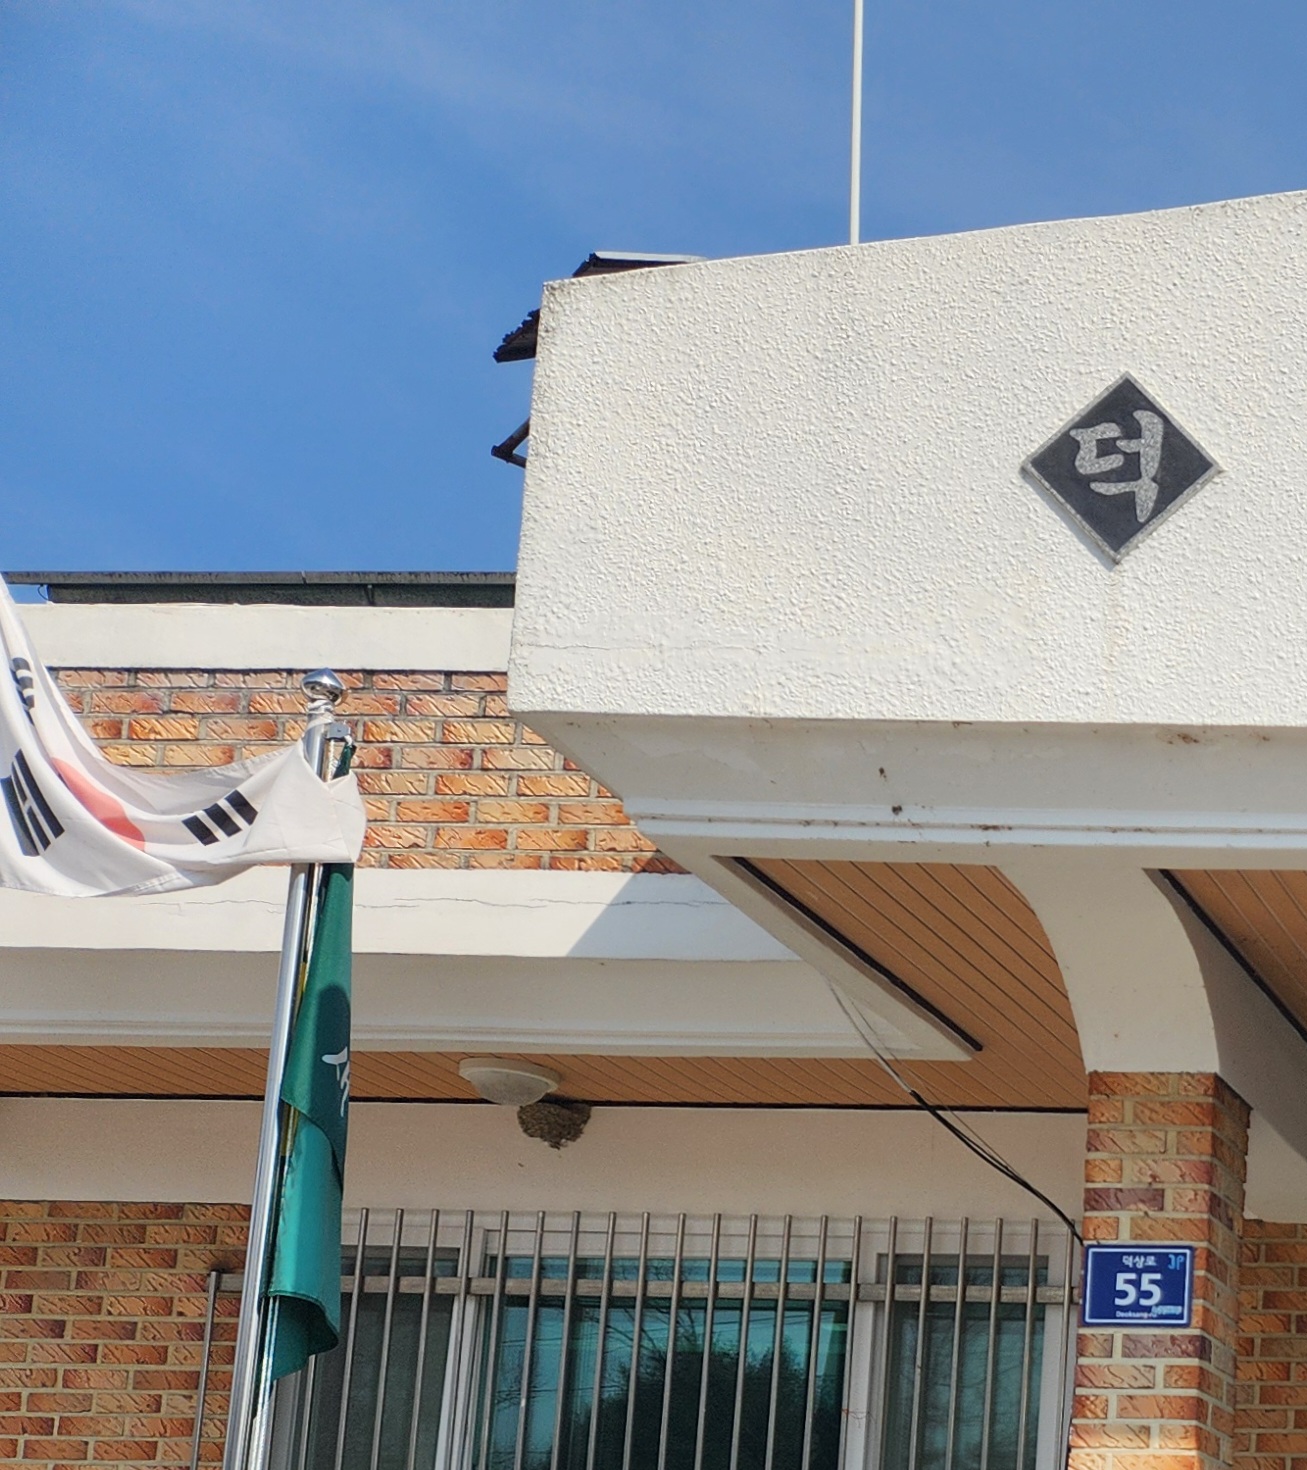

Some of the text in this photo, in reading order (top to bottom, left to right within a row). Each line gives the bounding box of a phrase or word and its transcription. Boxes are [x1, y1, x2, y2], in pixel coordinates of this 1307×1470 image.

[1072, 410, 1165, 523] 덕
[1121, 1255, 1157, 1269] 덕상로
[1114, 1272, 1163, 1307] 55
